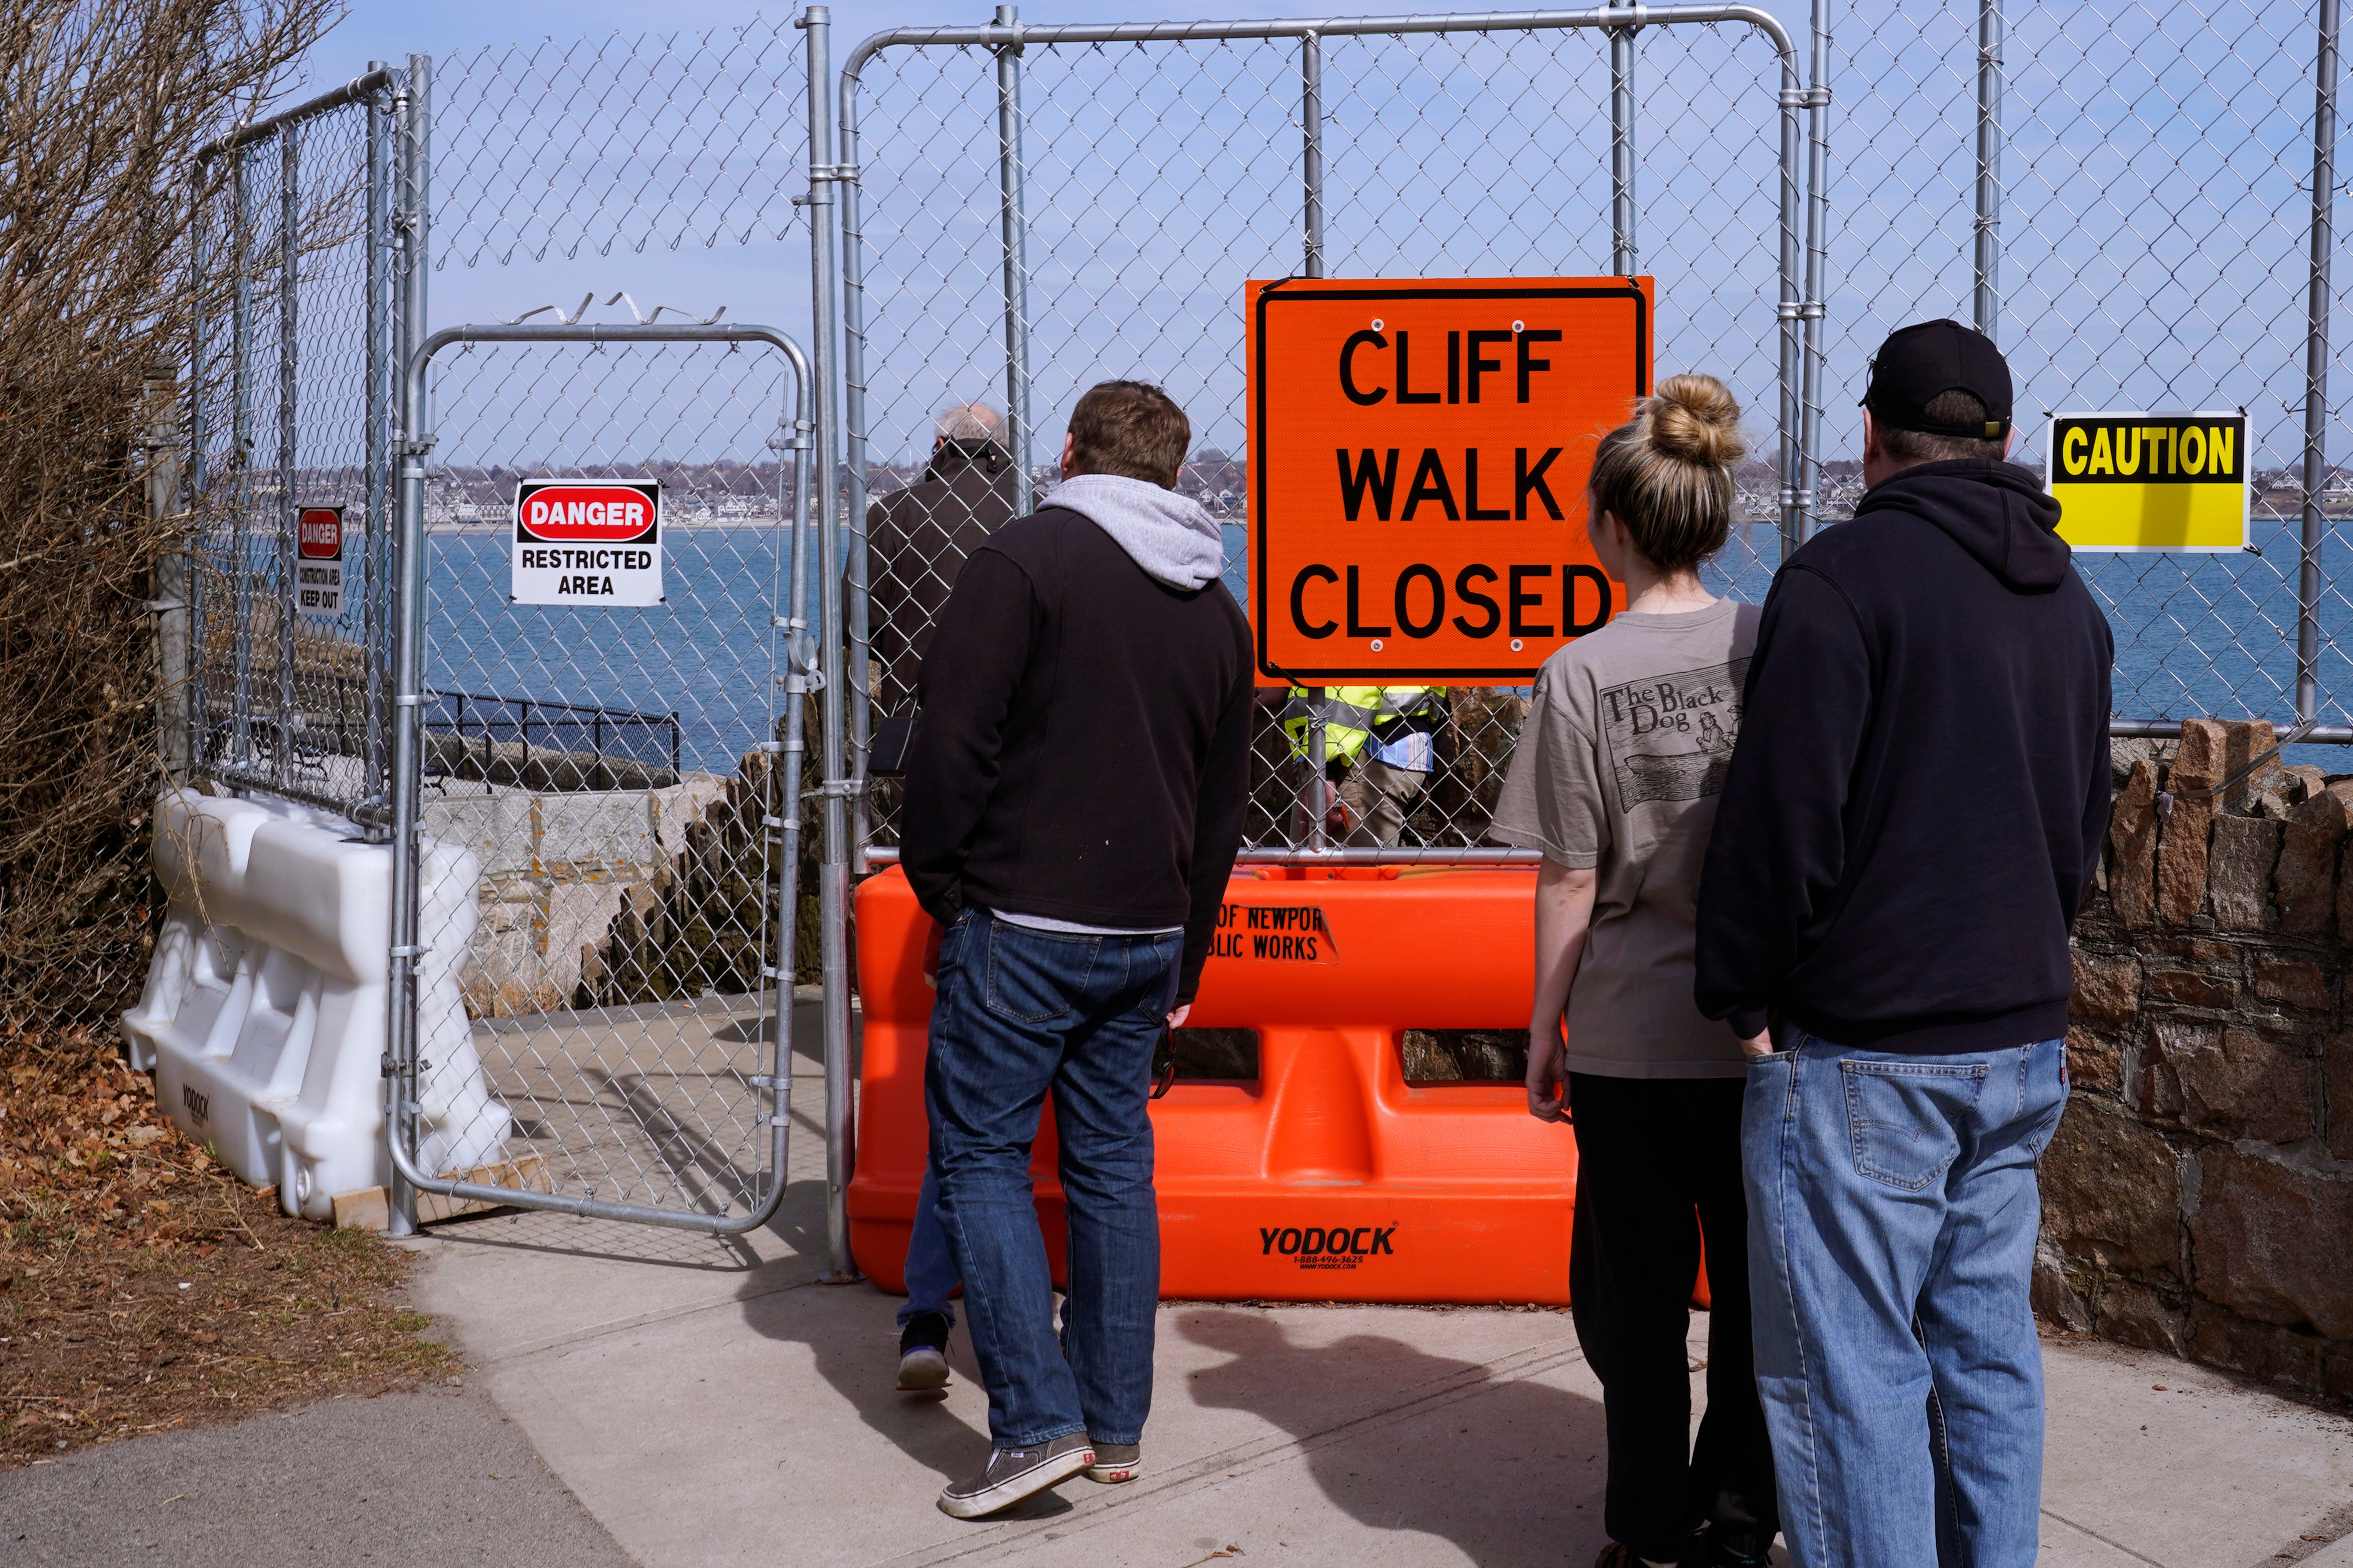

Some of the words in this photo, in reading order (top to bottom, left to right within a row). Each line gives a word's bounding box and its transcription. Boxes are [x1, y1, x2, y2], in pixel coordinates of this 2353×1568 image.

[1340, 329, 1562, 406] CLIFF
[2062, 425, 2235, 476] CAUTION
[1336, 447, 1565, 521] WALK
[530, 501, 644, 526] DANGER
[302, 522, 338, 545] DANGER
[522, 550, 652, 570] RESTRICTED
[299, 567, 329, 586] CONSTRUCTION
[329, 569, 340, 586] AREA
[558, 576, 614, 595] AREA
[300, 589, 320, 607] KEEP
[323, 591, 339, 609] OUT
[1290, 563, 1612, 639] CLOSED
[1603, 685, 1655, 722] The
[1655, 682, 1724, 713] Black
[1630, 704, 1690, 736] Dog
[1216, 904, 1240, 928] OF
[1247, 906, 1323, 931] NEWPOR
[1253, 935, 1317, 960] WORKS
[183, 1083, 209, 1121] YODOCK
[1260, 1228, 1396, 1255] YODOCK
